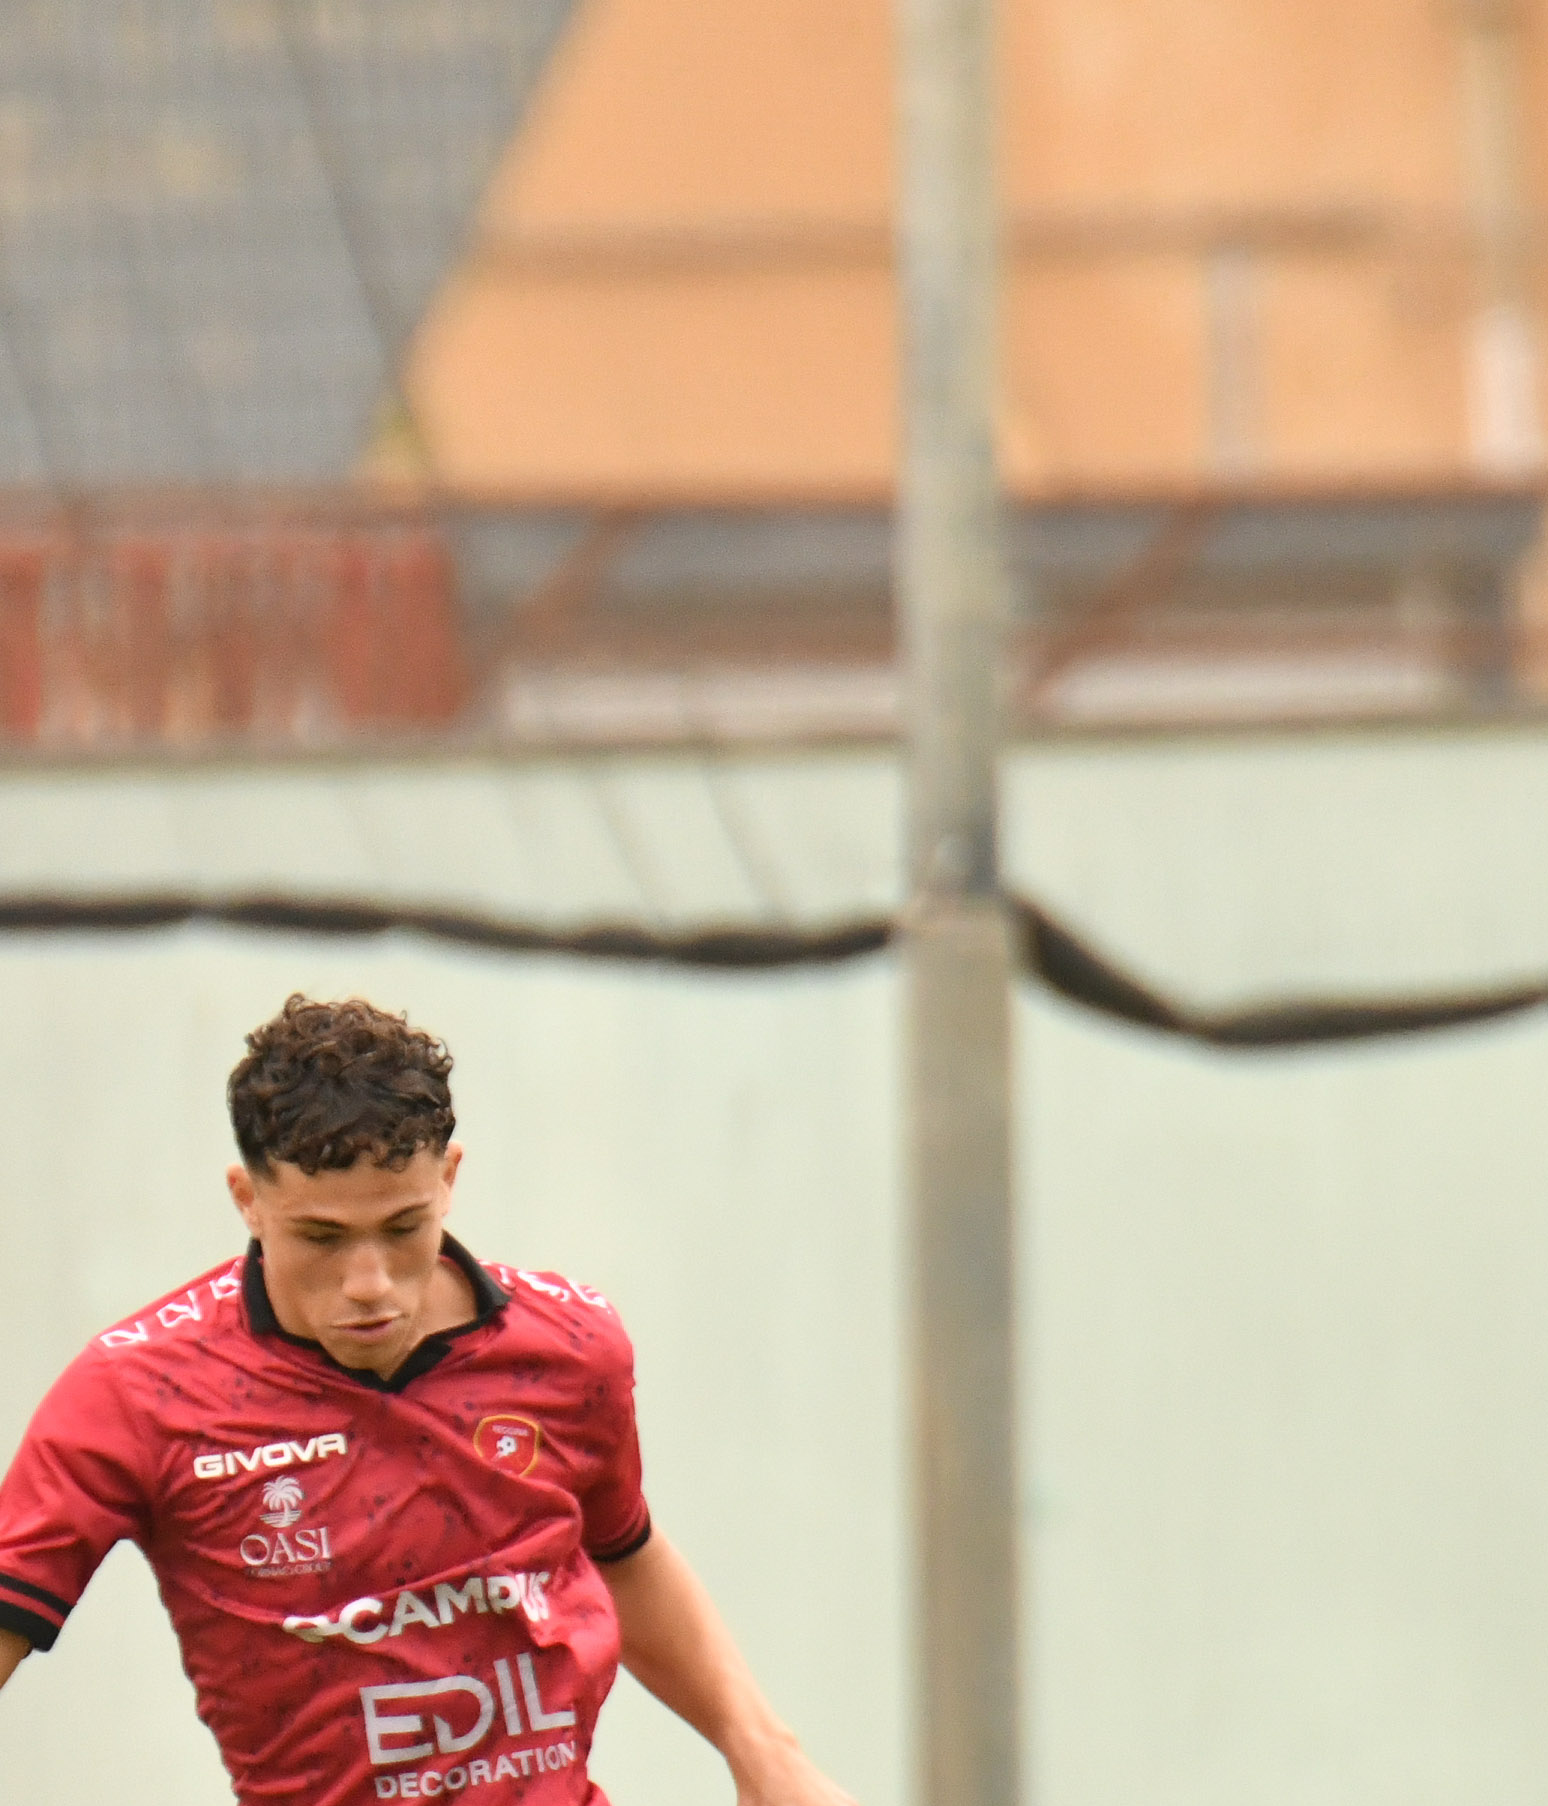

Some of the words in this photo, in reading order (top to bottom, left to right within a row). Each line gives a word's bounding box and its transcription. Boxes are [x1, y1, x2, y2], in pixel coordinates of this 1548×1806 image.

[194, 1433, 348, 1479] GIVOVA
[240, 1527, 332, 1566] OASI
[359, 1652, 576, 1764] EDIL
[374, 1741, 577, 1798] DECORATION
